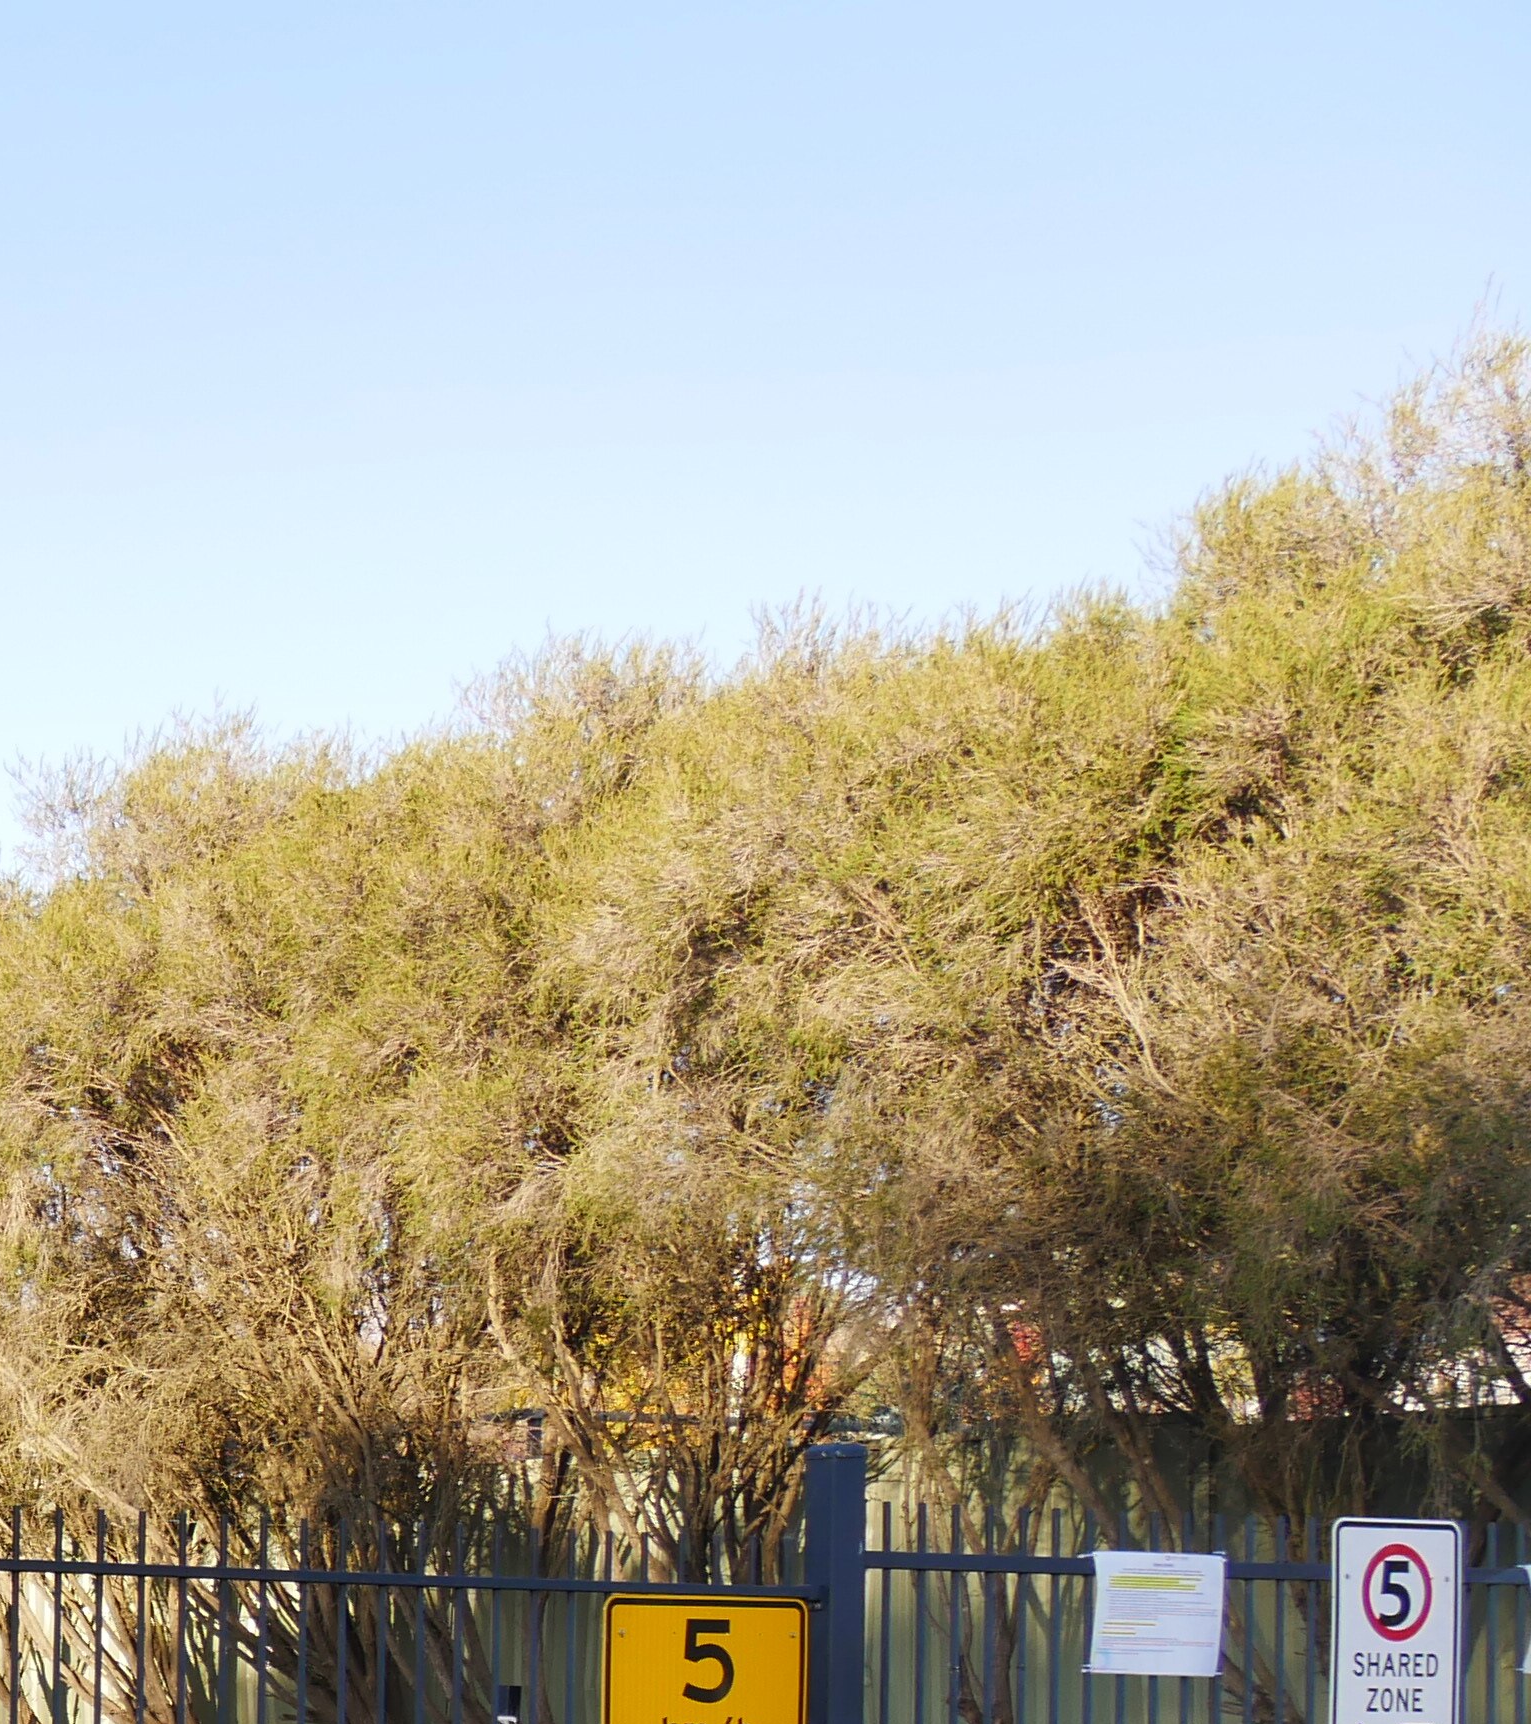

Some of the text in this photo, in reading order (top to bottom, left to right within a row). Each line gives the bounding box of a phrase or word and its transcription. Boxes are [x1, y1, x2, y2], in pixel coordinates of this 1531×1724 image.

[1378, 1560, 1411, 1628] 5
[682, 1618, 735, 1704] 5
[1352, 1652, 1439, 1678] SHARED
[1366, 1688, 1424, 1713] ZONE
